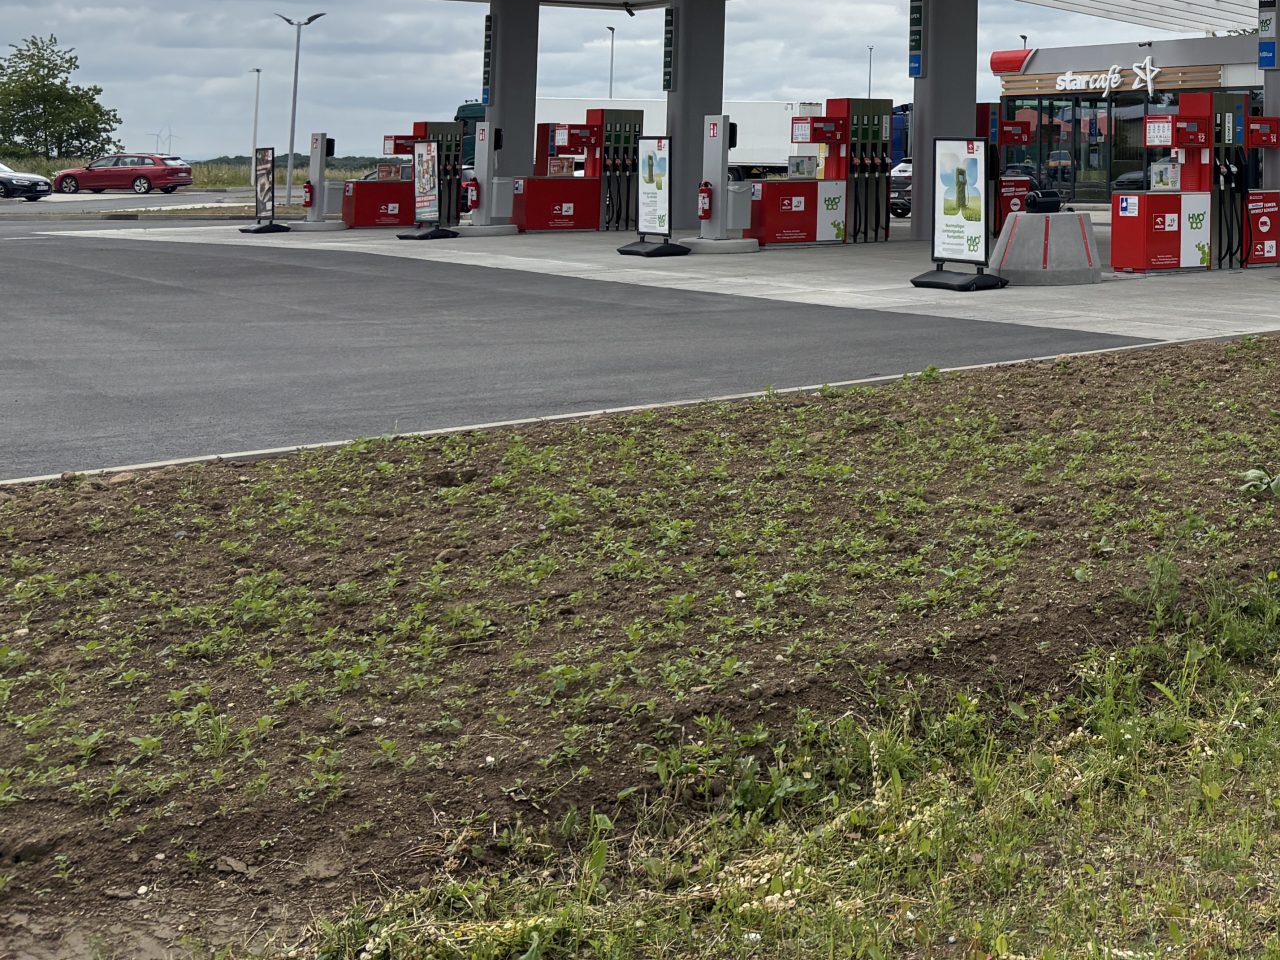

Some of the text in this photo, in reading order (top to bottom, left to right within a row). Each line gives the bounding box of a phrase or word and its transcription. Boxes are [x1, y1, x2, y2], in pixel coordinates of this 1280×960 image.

[1055, 64, 1123, 98] starcafé
[1188, 213, 1204, 222] HVO
[1189, 221, 1202, 230] 100
[966, 235, 981, 245] HVO
[968, 244, 979, 252] 100
